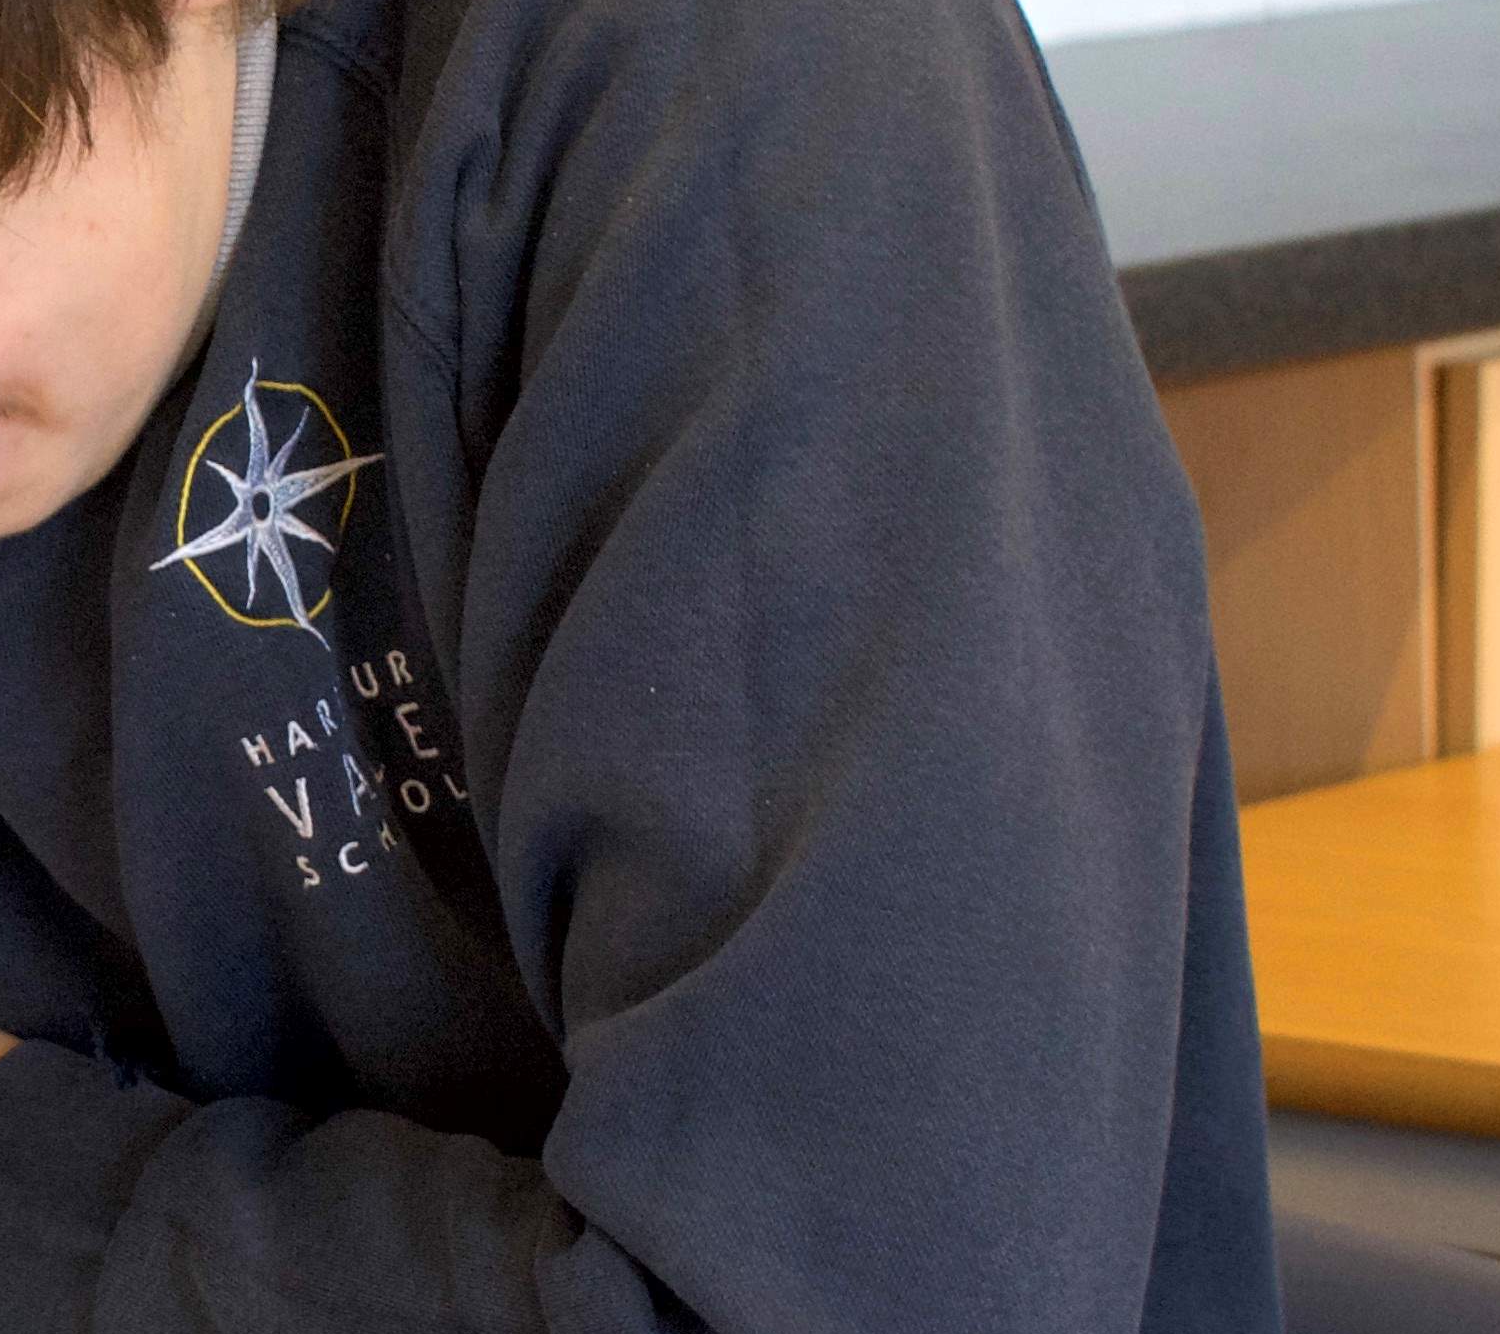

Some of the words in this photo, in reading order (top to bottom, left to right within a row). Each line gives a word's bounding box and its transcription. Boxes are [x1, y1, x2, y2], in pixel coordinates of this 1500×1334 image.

[240, 650, 415, 768] HARUR
[265, 702, 439, 840] VAE
[296, 772, 467, 889] SCHOL
